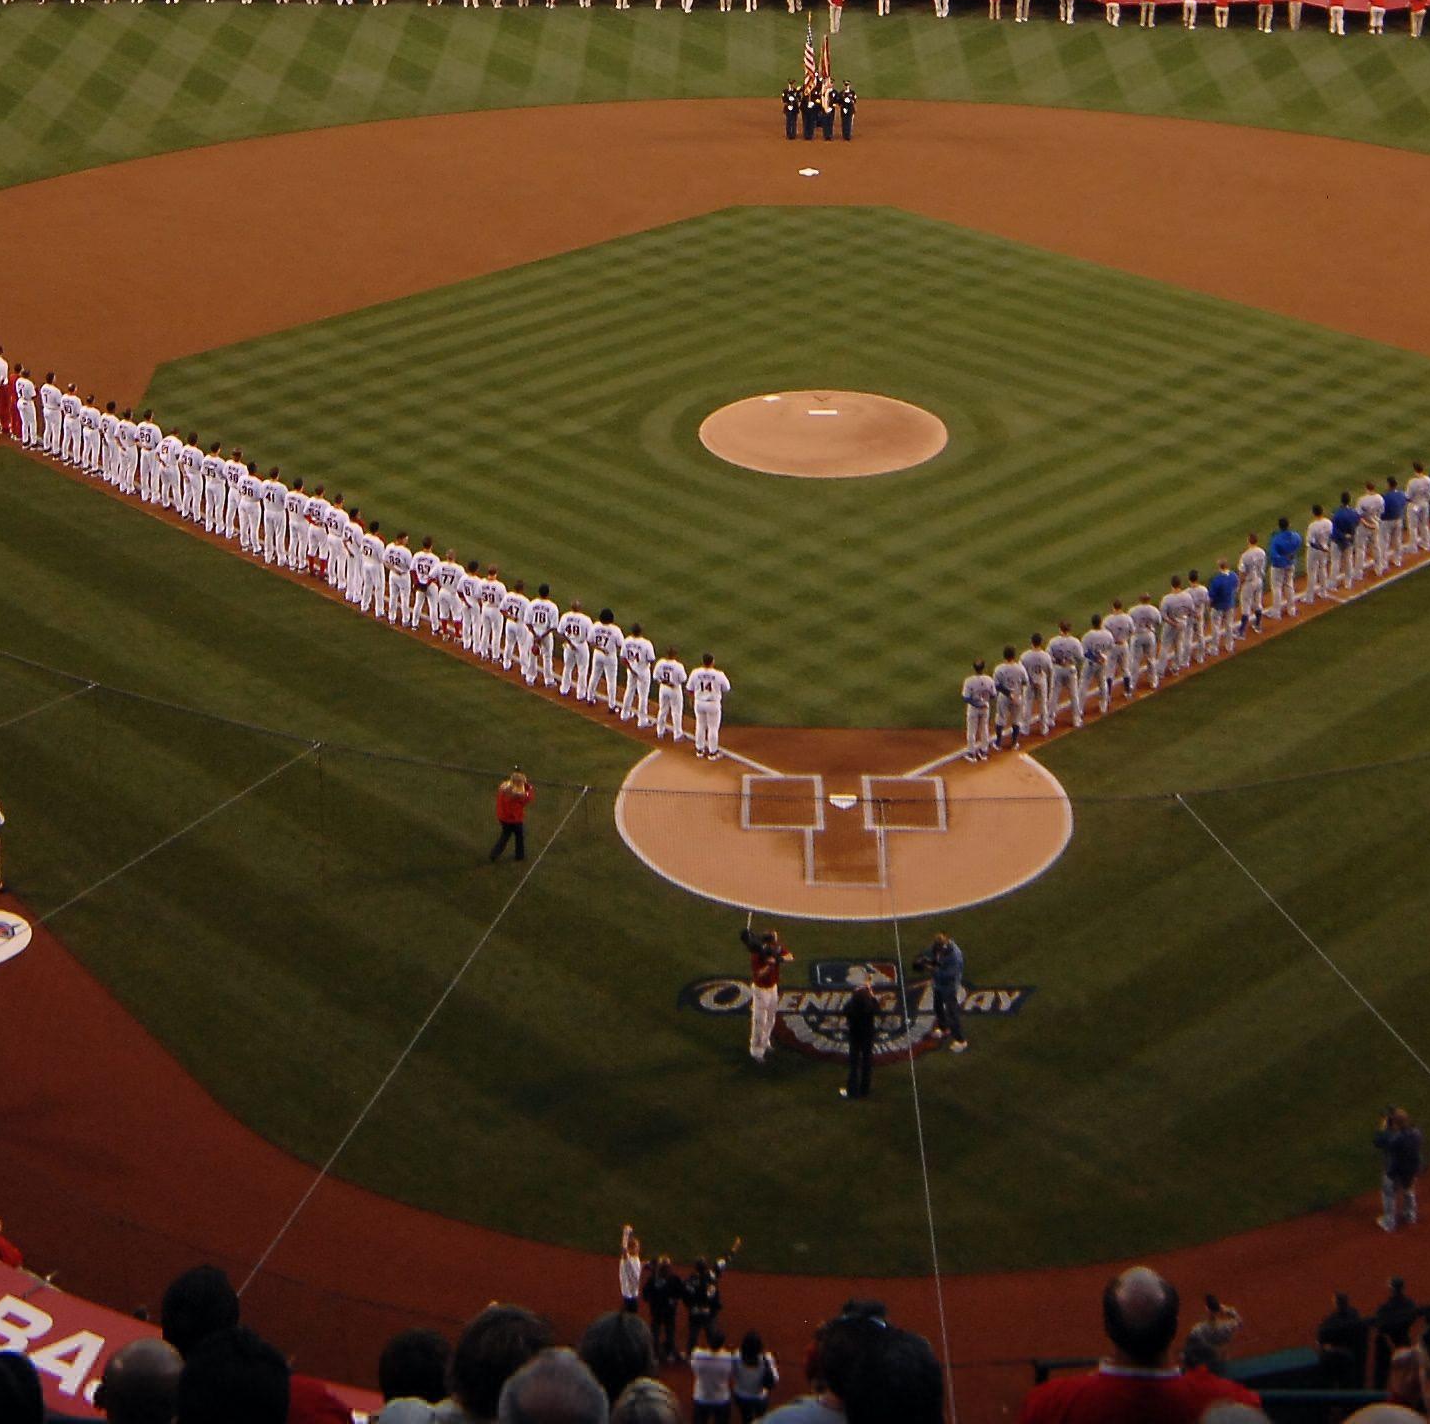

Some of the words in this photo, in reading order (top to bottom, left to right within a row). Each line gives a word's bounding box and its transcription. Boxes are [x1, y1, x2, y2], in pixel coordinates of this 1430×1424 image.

[266, 492, 275, 503] 41
[442, 574, 454, 584] 77
[508, 606, 519, 617] 47
[534, 612, 546, 624] 18
[700, 681, 712, 692] 14
